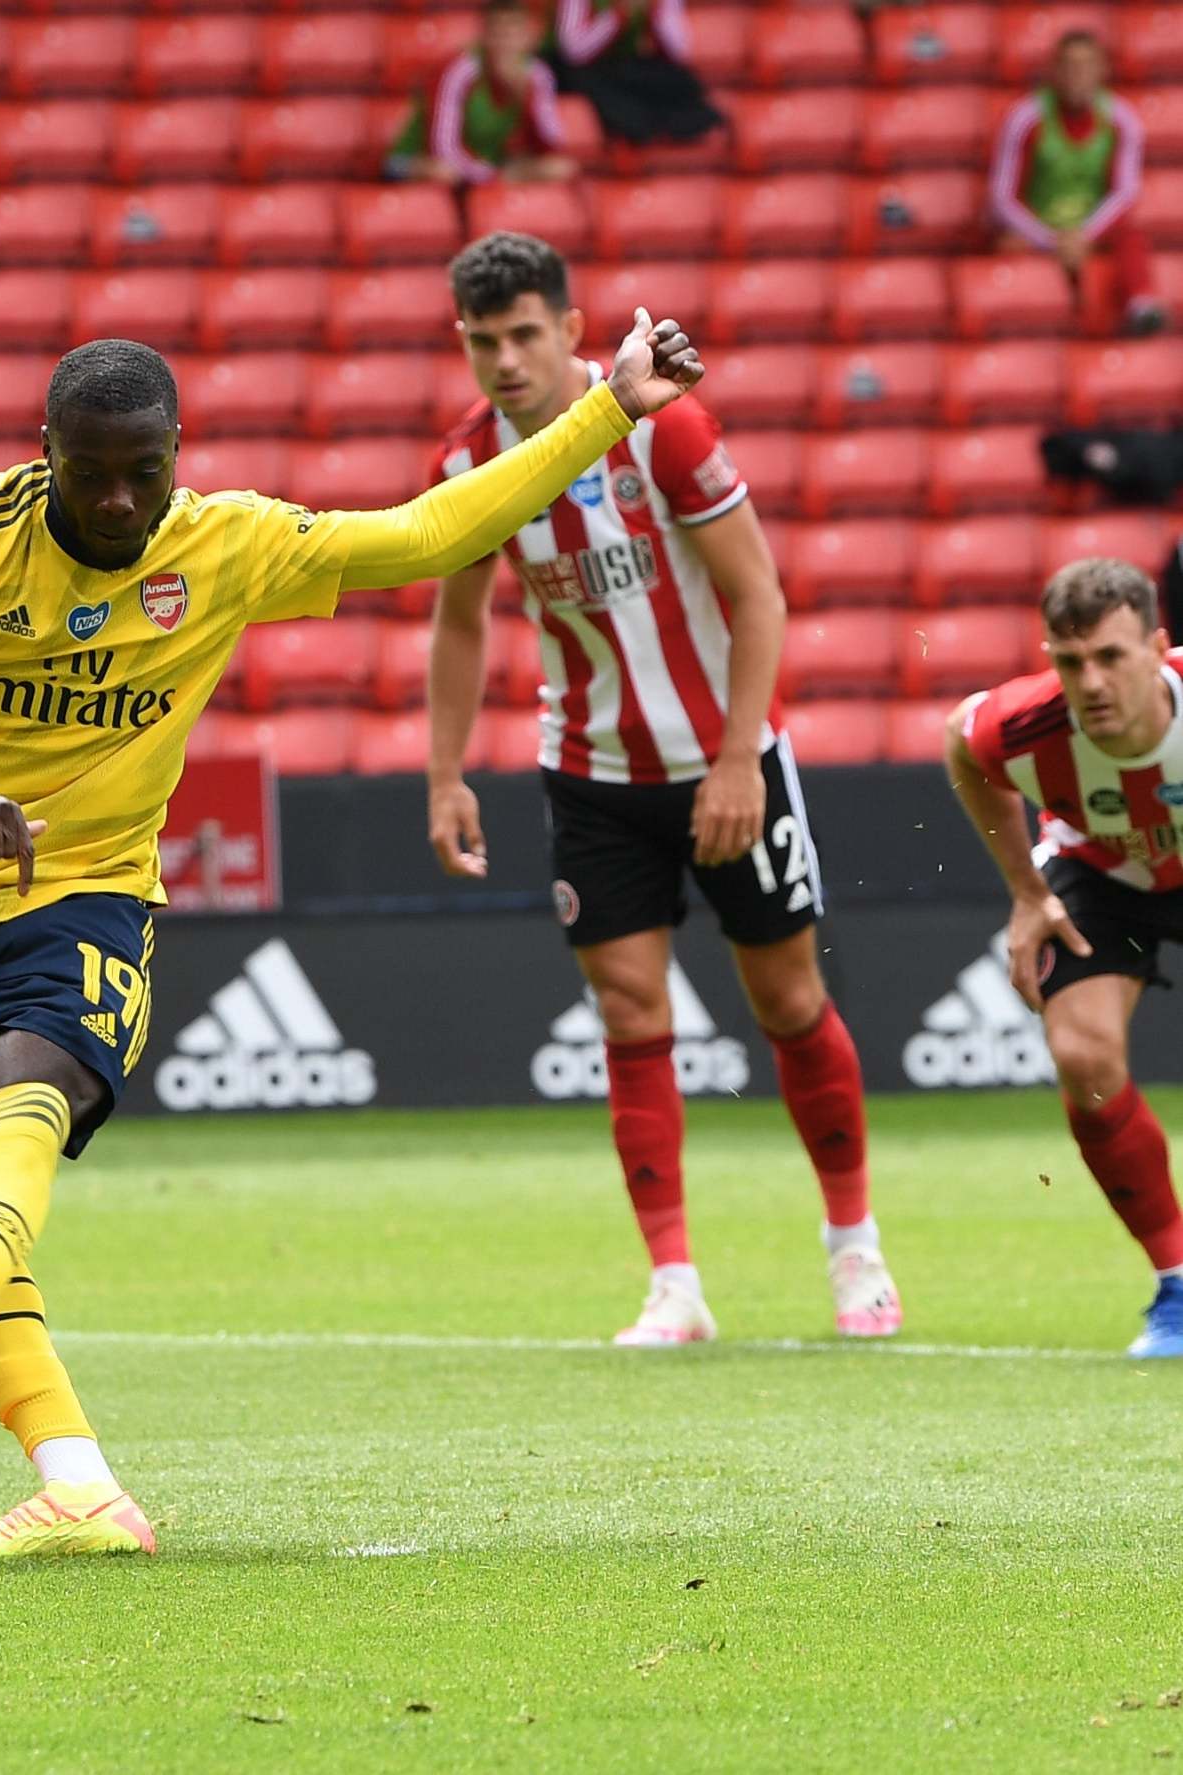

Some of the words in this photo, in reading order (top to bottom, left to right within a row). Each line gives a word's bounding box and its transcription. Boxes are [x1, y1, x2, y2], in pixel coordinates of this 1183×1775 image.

[146, 580, 181, 594] Arsenal
[76, 612, 103, 630] NHS
[751, 815, 809, 894] 12
[77, 942, 145, 1029] 19
[80, 1015, 118, 1048] adidas
[155, 1049, 377, 1109] adidas
[531, 1036, 750, 1099] adas
